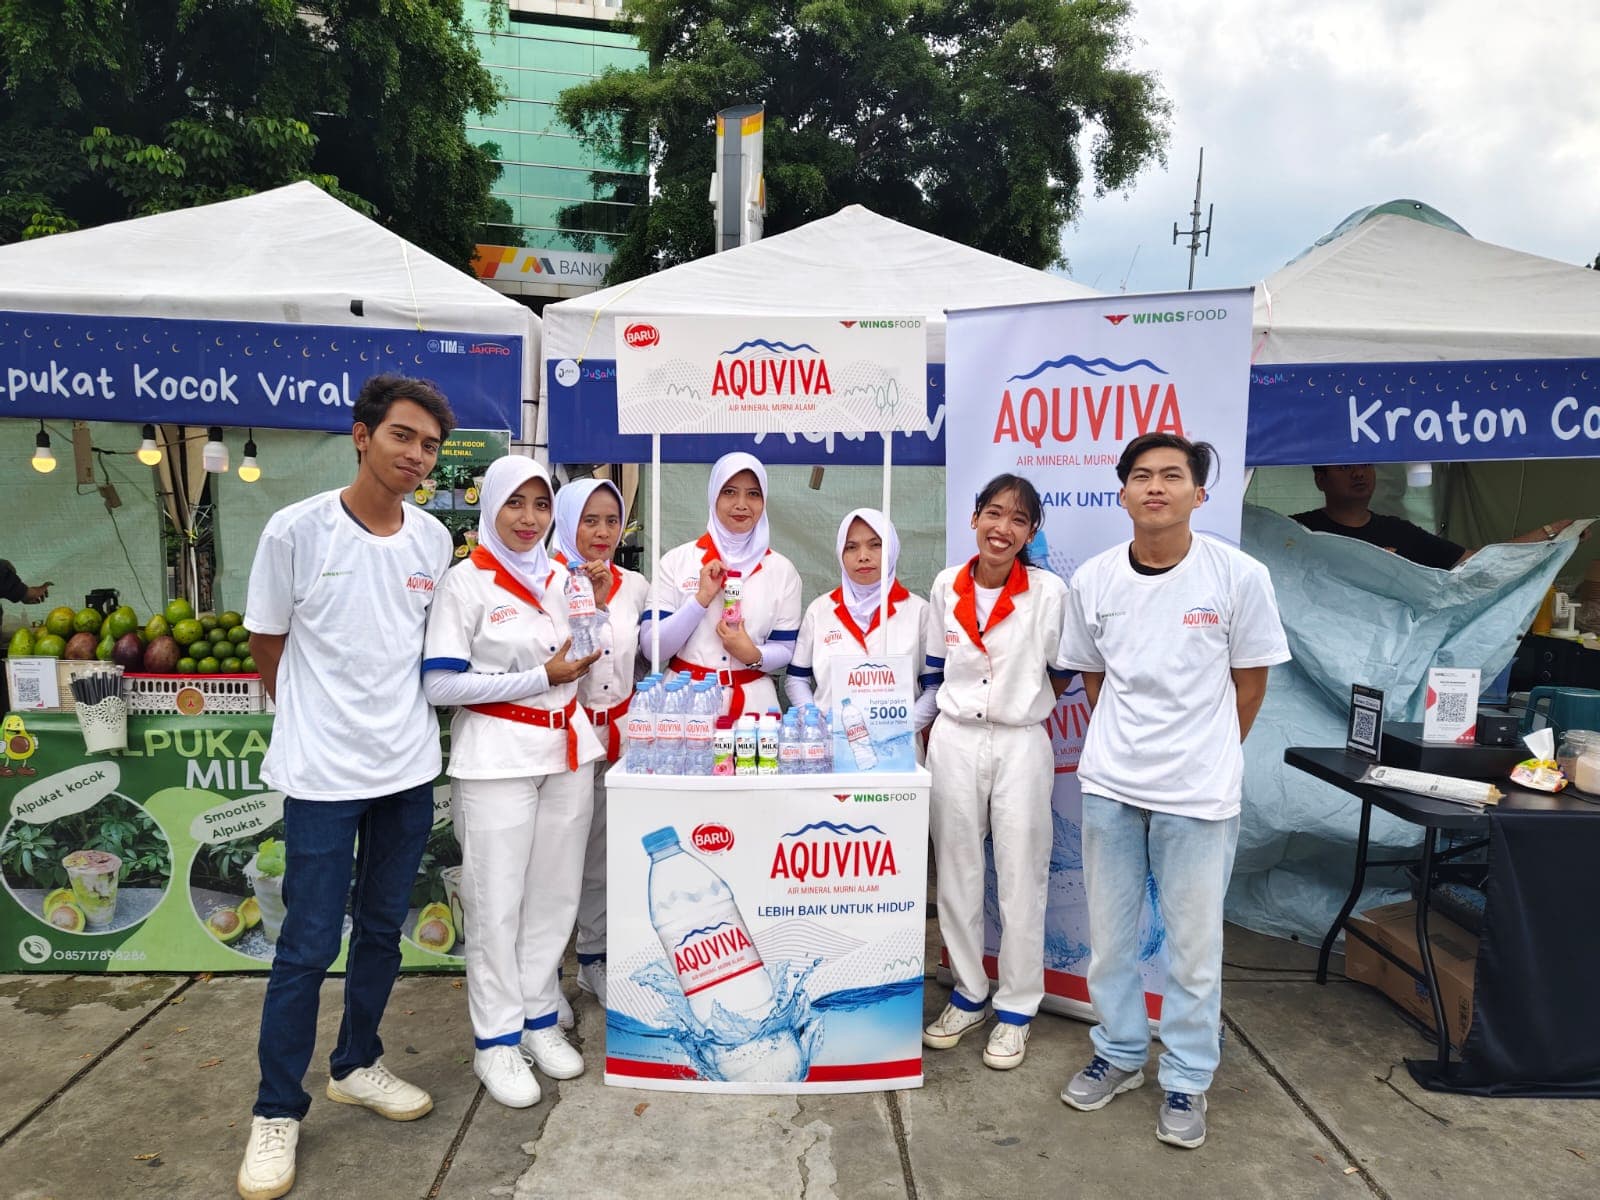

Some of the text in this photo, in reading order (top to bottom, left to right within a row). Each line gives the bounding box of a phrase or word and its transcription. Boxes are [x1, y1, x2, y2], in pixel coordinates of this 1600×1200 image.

[859, 320, 921, 329] WINGSFOOD
[1133, 309, 1227, 324] WINGSFOOD
[626, 330, 656, 345] BARU
[440, 340, 457, 353] TIM
[1, 361, 354, 407] pukat Kocok Viral
[711, 359, 832, 399] AQUVIVA
[993, 383, 1185, 448] AQUVIVA
[1349, 396, 1600, 445] Kraton Co
[1017, 454, 1118, 466] AIR MINERAL MURNI
[1039, 491, 1121, 507] AIK UNTU
[1183, 613, 1219, 625] AQUVIVA
[848, 671, 896, 687] AQUVIVA
[869, 706, 907, 719] 5000
[84, 729, 269, 758] PUKA
[186, 759, 264, 790] MIL
[16, 770, 106, 817] Alpukat kocok
[853, 792, 917, 802] WINGSFOOD
[203, 798, 267, 824] Smoothis
[212, 817, 263, 840] Alpukat
[694, 831, 729, 847] BARU
[770, 840, 897, 882] AQUVIVA
[801, 886, 832, 894] MINERAL
[857, 885, 880, 893] ALAMI
[758, 901, 915, 918] LEBIH BAIK UNTUK HIDUP
[673, 927, 752, 976] AQUVIVA
